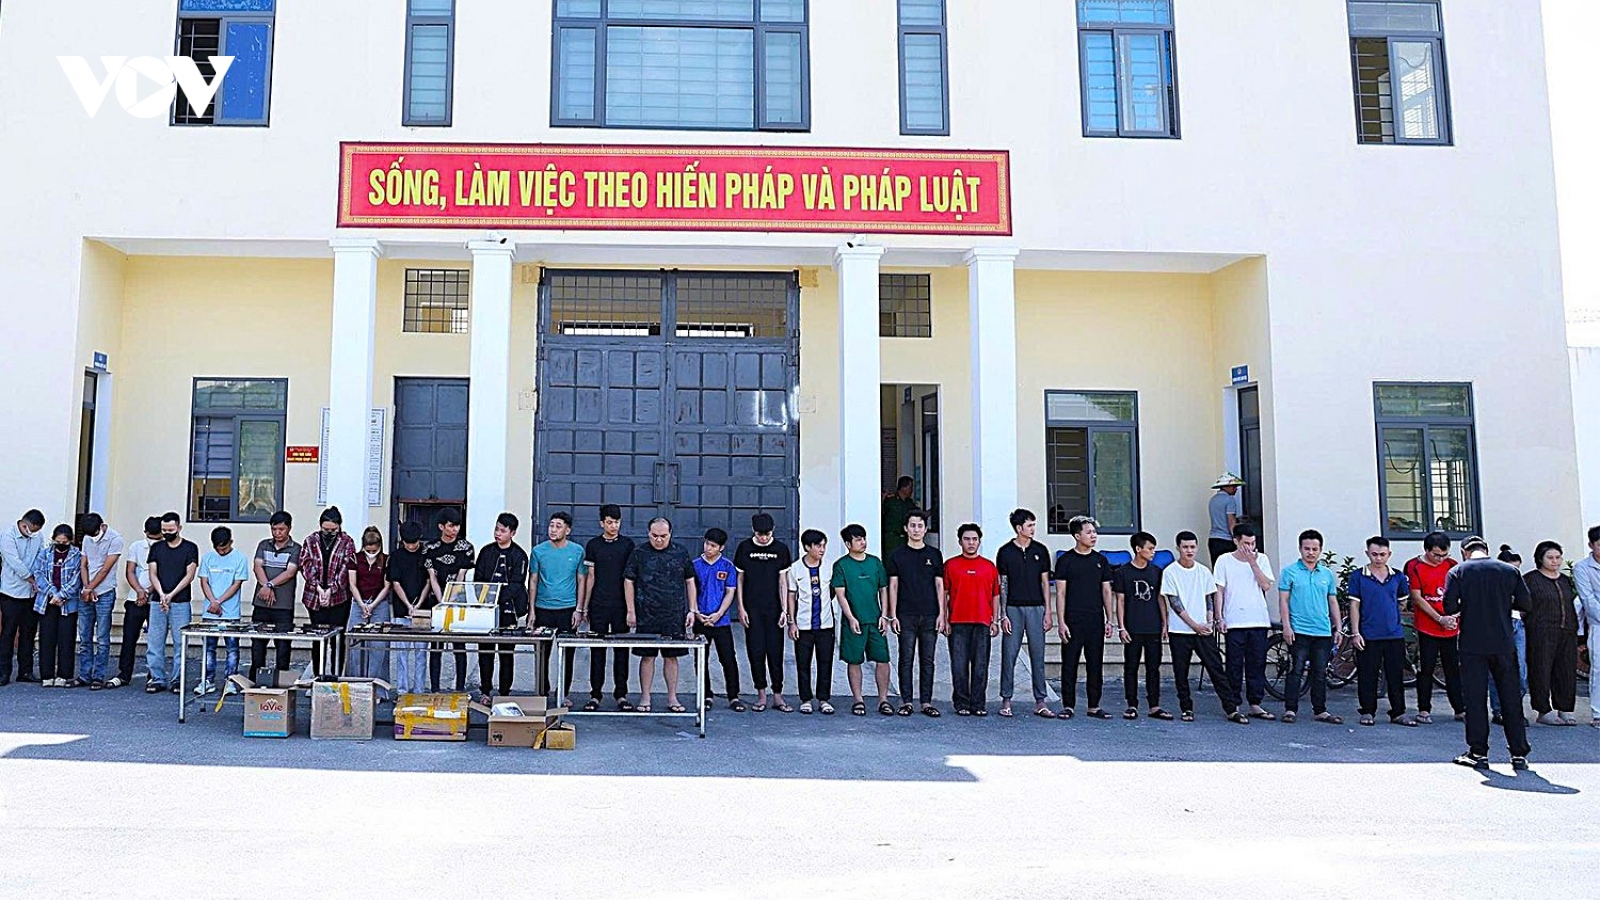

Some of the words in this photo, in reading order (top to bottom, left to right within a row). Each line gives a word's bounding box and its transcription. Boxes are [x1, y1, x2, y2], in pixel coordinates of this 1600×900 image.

[368, 156, 447, 211] SỐNG,
[455, 162, 511, 207] LÀM
[518, 163, 576, 215] VIỆC
[584, 171, 648, 208] THEO
[656, 160, 717, 209] HIẾN
[725, 165, 794, 210] PHÁP
[801, 166, 836, 210] VÀ
[843, 167, 912, 212] PHÁP
[919, 168, 981, 221] LUẬT
